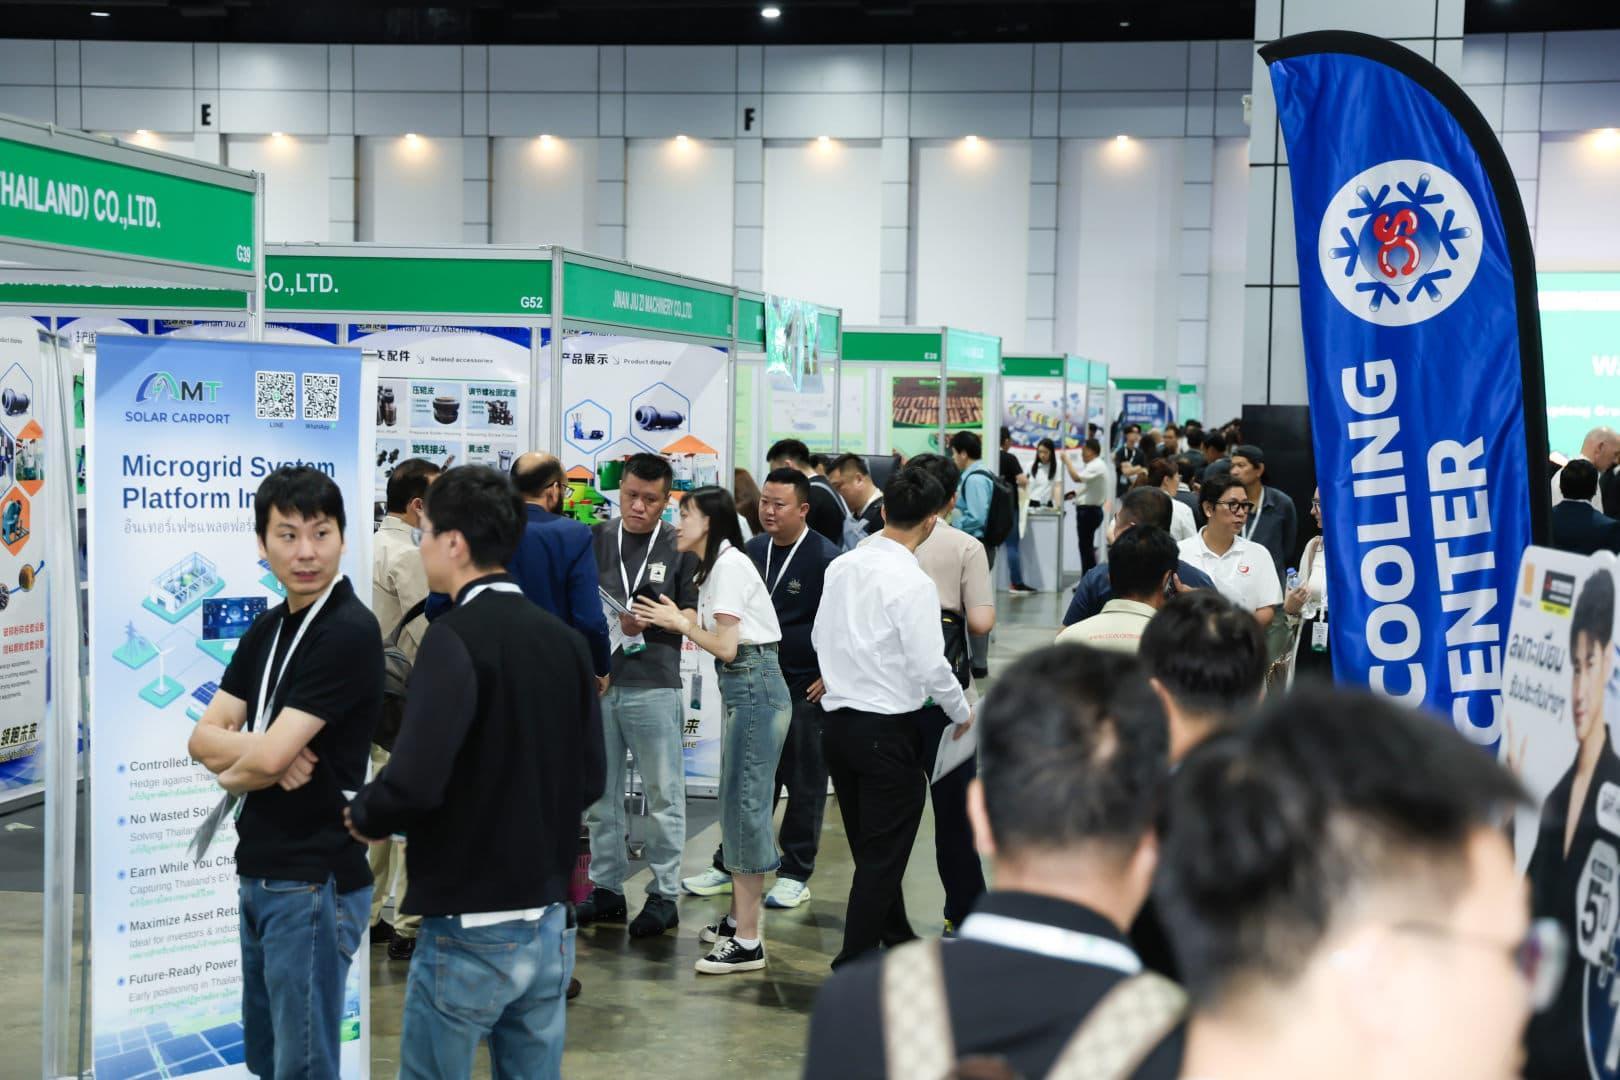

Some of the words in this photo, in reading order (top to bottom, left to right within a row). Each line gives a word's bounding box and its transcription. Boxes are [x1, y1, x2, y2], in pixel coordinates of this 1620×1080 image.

[201, 104, 212, 126] E
[744, 108, 755, 131] F
[93, 188, 161, 230] CO.,LTD.
[236, 244, 251, 263] G39
[520, 296, 544, 309] G52
[125, 411, 167, 422] SOLAR
[172, 412, 230, 424] CARPORT
[122, 454, 242, 482] Microgrid
[123, 487, 231, 509] Platform
[1341, 358, 1427, 711] COOLING
[1426, 435, 1502, 747] CENTER
[130, 757, 188, 772] Controlled
[130, 814, 147, 825] No
[149, 808, 190, 822] Wasted
[130, 867, 157, 878] Earn
[159, 861, 189, 875] While
[193, 858, 213, 869] You
[130, 914, 181, 932] Maximize
[183, 909, 214, 922] Asset
[129, 963, 201, 985] Future-Ready
[205, 958, 238, 972] Power
